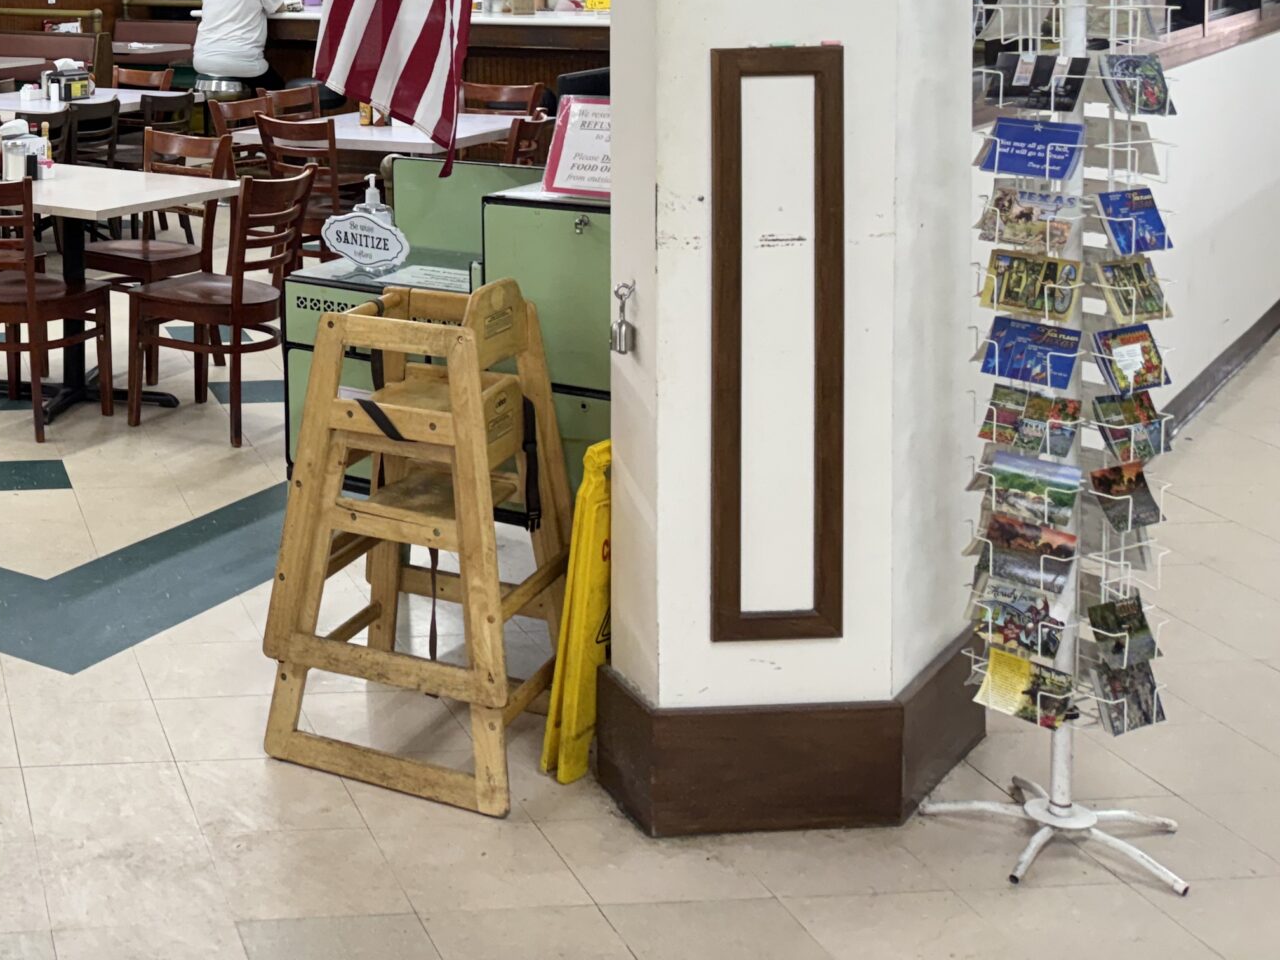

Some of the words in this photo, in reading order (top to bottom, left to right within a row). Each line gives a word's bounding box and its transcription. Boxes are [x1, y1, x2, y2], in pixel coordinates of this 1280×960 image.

[570, 162, 598, 172] FOOD
[1019, 191, 1076, 208] TEXAS
[335, 229, 390, 251] SANITIZE
